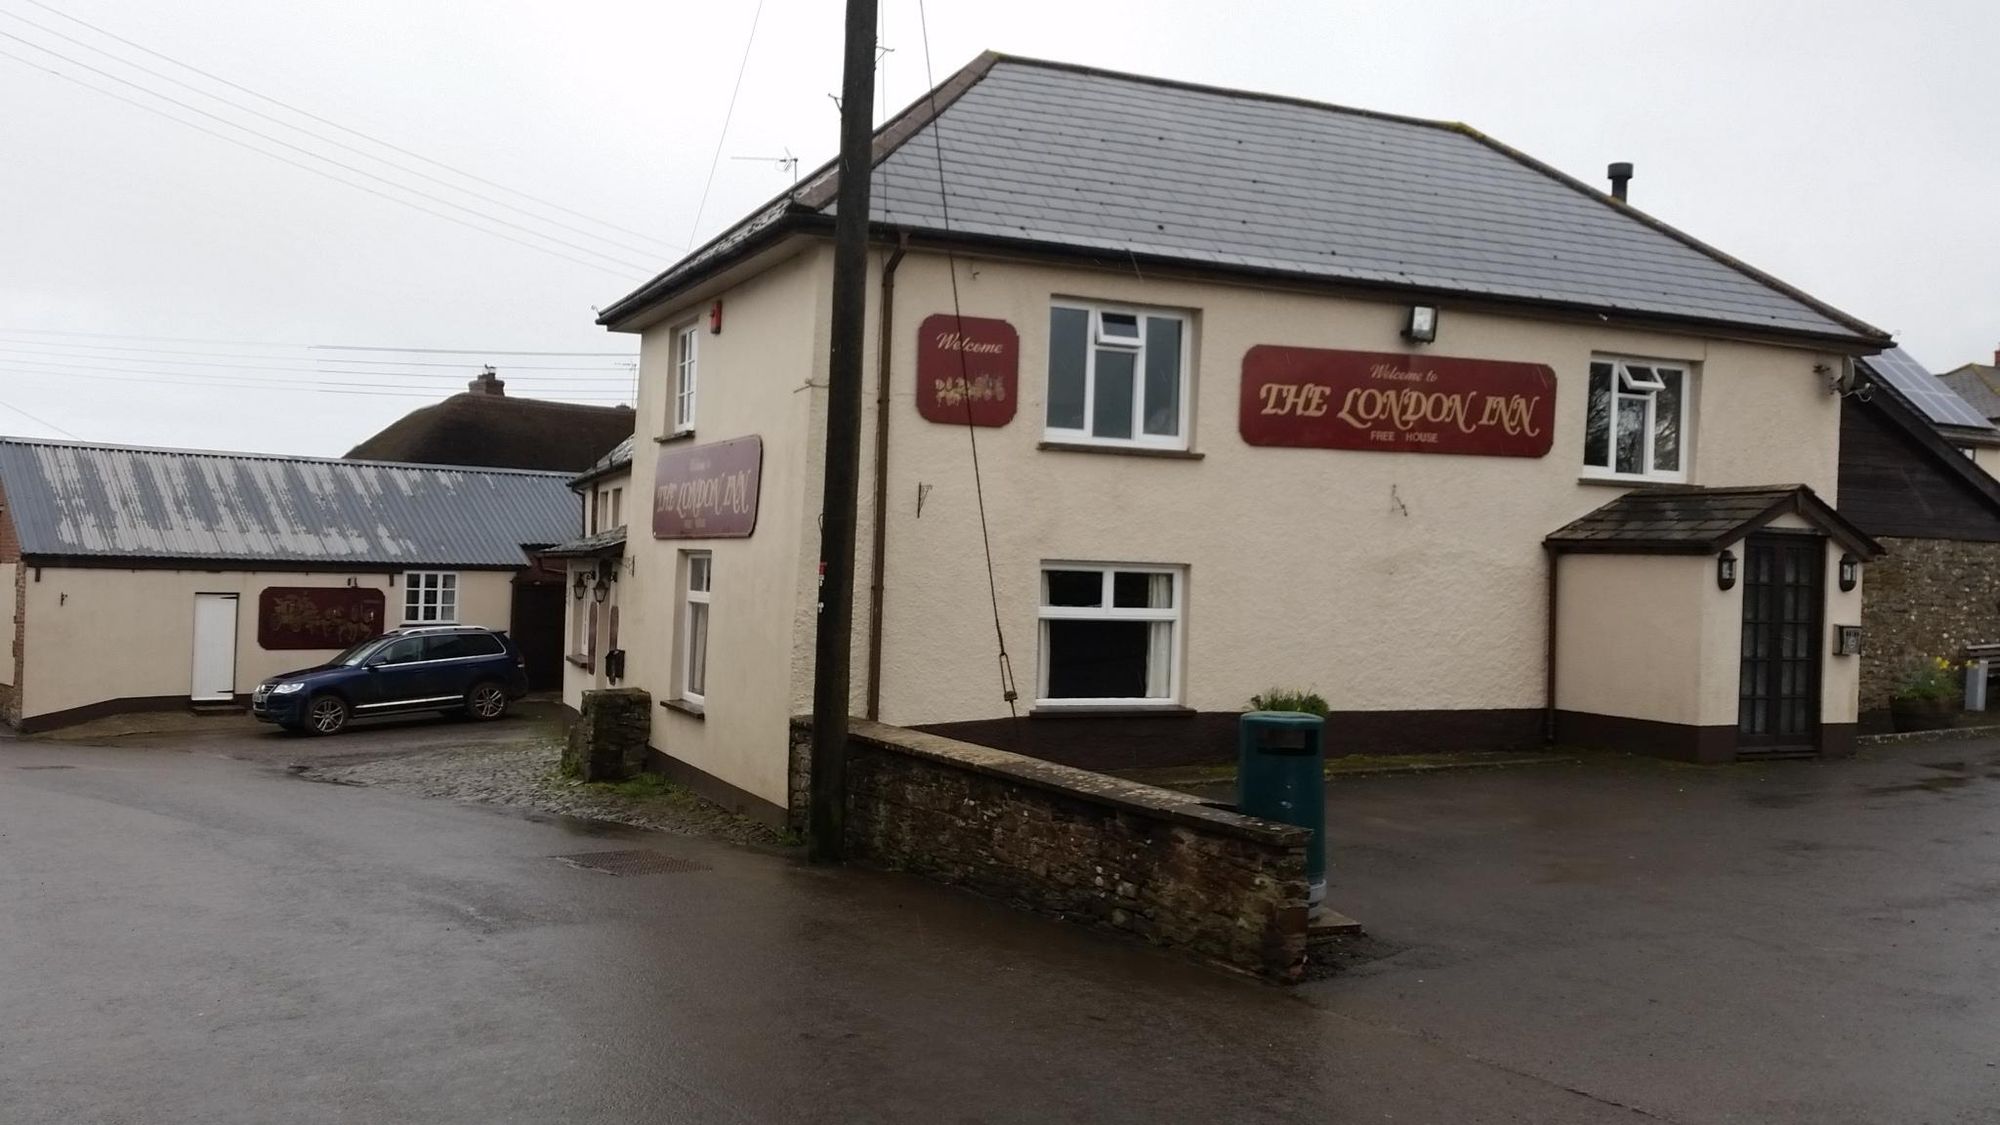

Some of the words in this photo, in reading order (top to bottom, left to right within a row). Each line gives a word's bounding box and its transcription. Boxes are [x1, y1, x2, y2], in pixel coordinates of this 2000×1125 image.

[936, 332, 1004, 354] Welcome
[1369, 364, 1423, 382] Welcome
[1426, 369, 1438, 383] to
[1259, 383, 1332, 417] THE
[1337, 388, 1477, 434] LONDON
[1478, 394, 1540, 437] INN
[1370, 430, 1396, 443] FREE
[1405, 431, 1439, 444] HOUSE
